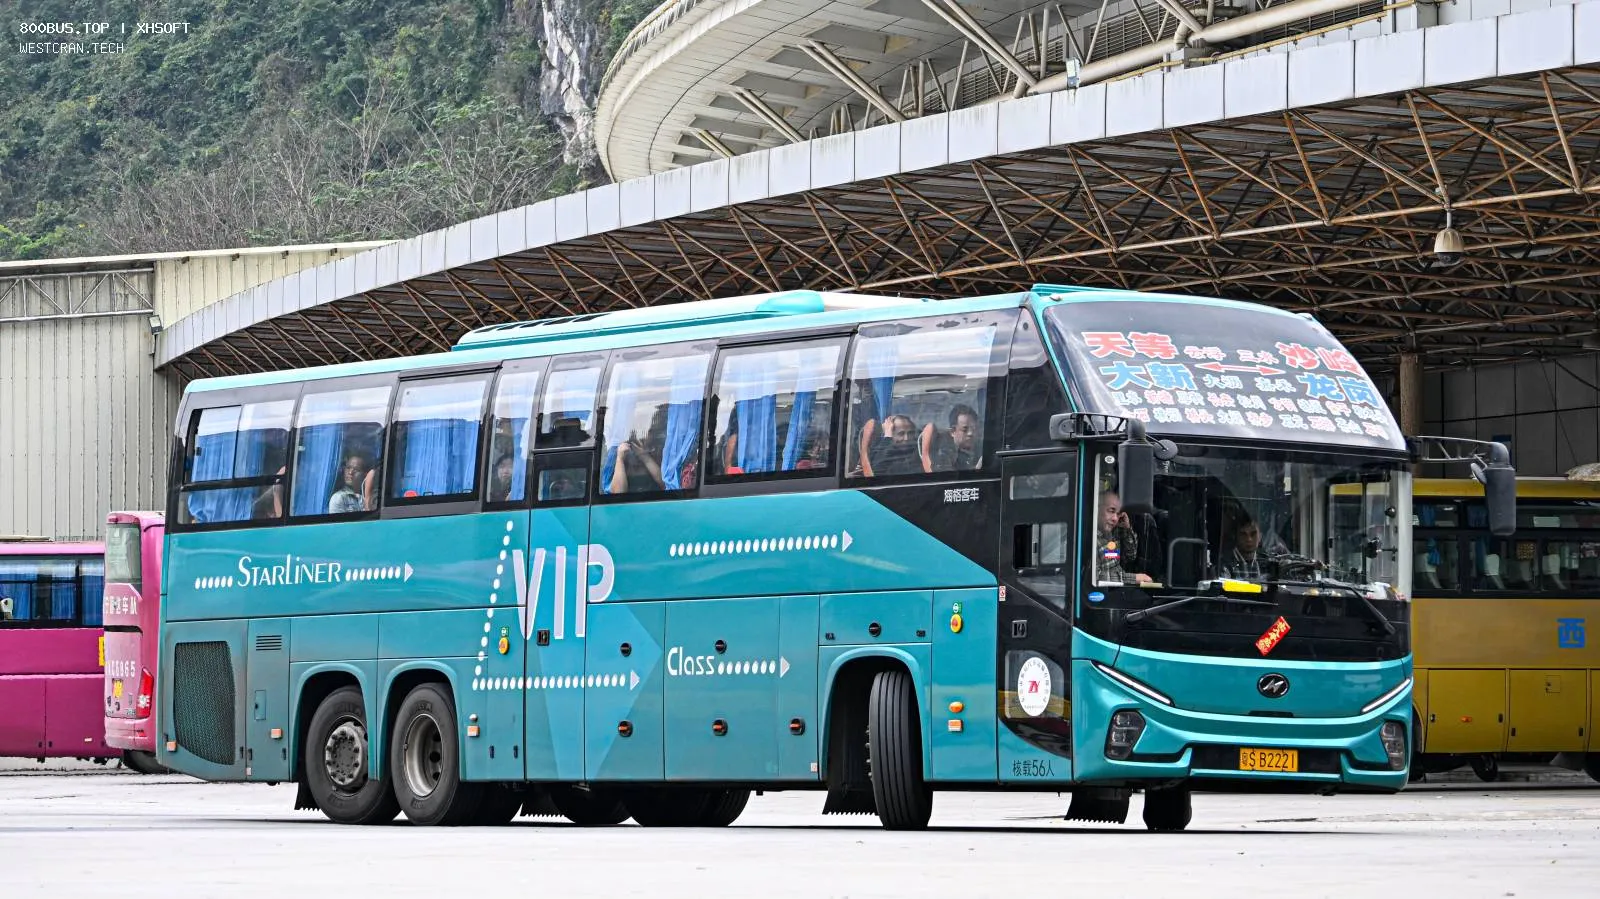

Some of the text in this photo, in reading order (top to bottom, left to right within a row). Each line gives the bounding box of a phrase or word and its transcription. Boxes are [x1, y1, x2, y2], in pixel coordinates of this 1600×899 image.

[1081, 331, 1179, 360] 天等
[1099, 361, 1198, 390] 大新
[944, 487, 980, 504] 海格客车
[512, 543, 615, 641] VIP
[1557, 617, 1586, 649] 西
[667, 646, 715, 676] Class
[1012, 759, 1055, 777] 核载56人
